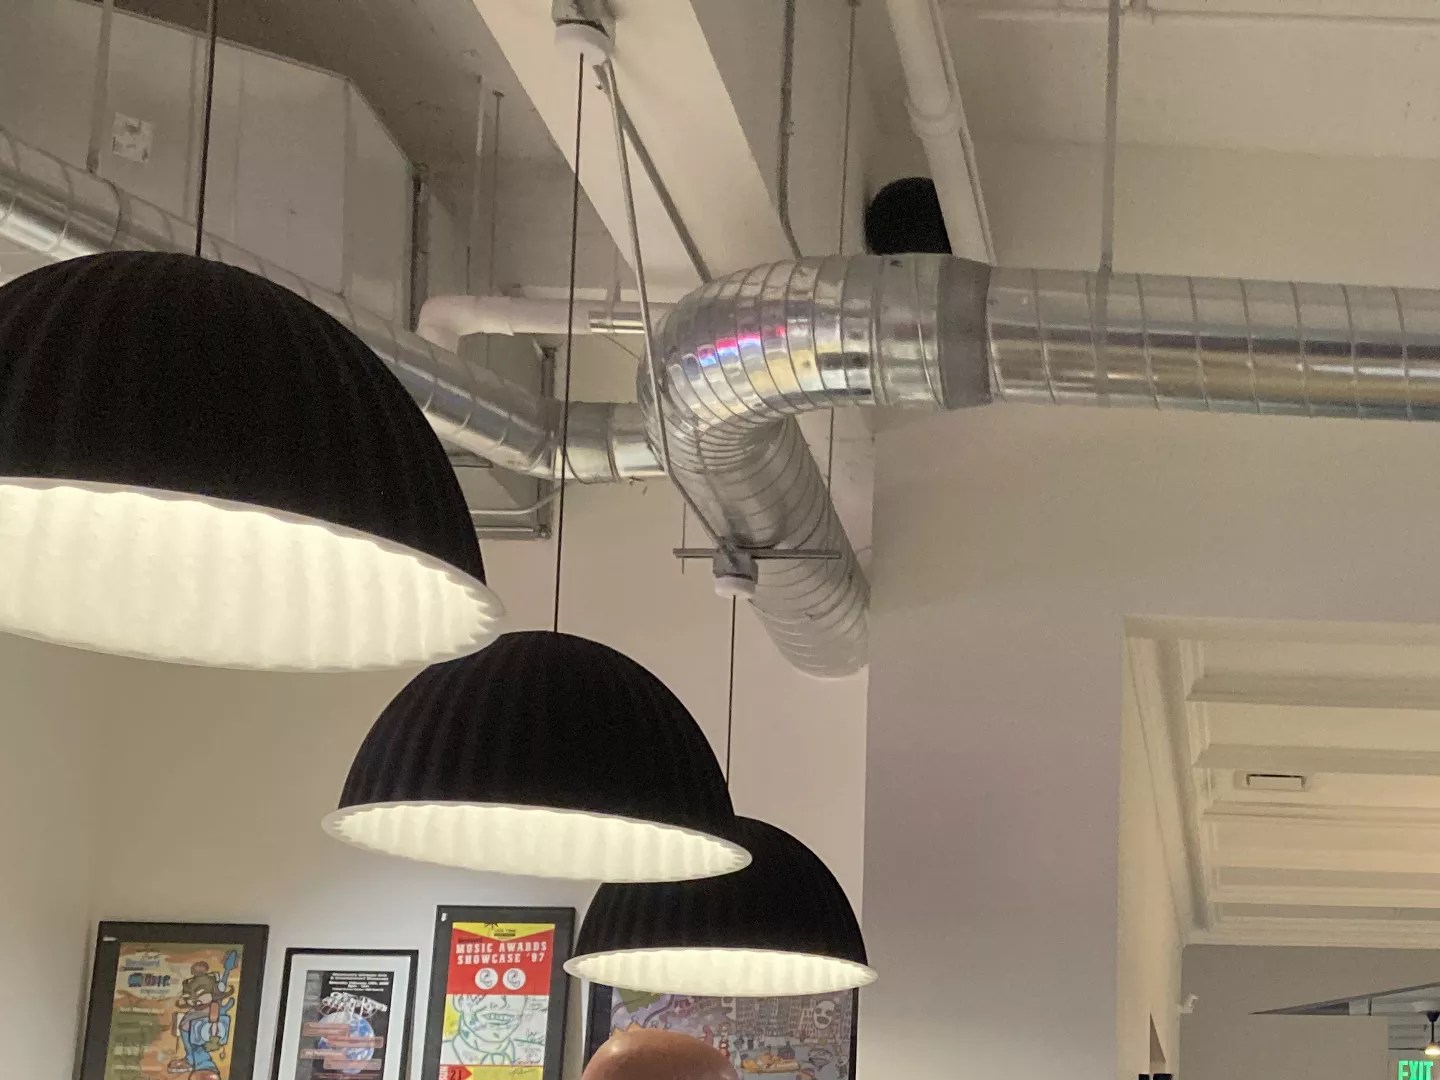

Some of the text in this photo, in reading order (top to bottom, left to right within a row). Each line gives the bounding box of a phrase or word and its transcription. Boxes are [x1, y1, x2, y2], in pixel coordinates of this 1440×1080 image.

[456, 941, 547, 954] MUSIC AWARDS
[457, 953, 521, 965] SHOWCASE
